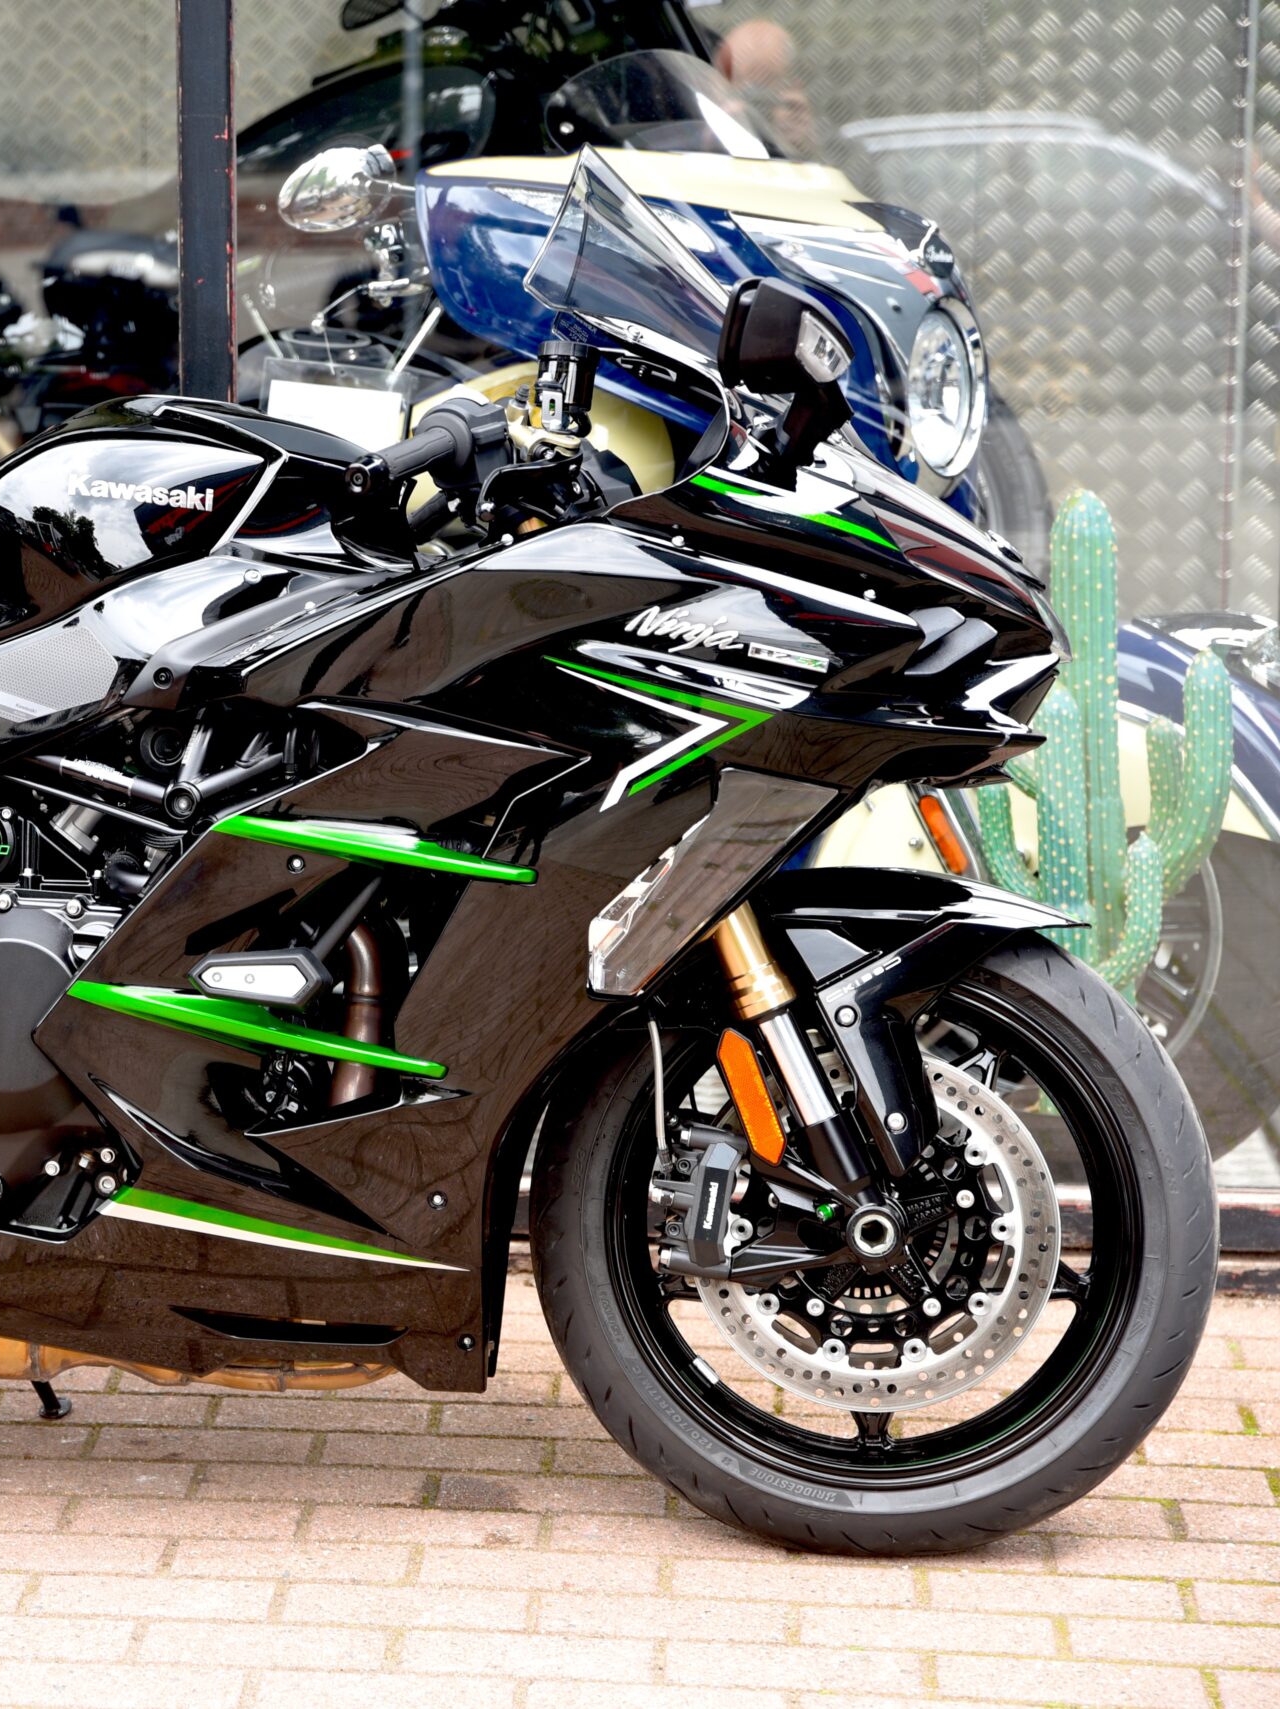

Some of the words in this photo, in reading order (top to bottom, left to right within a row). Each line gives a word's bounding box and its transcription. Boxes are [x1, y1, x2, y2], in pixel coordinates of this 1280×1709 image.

[69, 473, 214, 512] Kawasaki
[625, 605, 744, 652] Ninja
[749, 1467, 836, 1502] BRIDGESTONE
